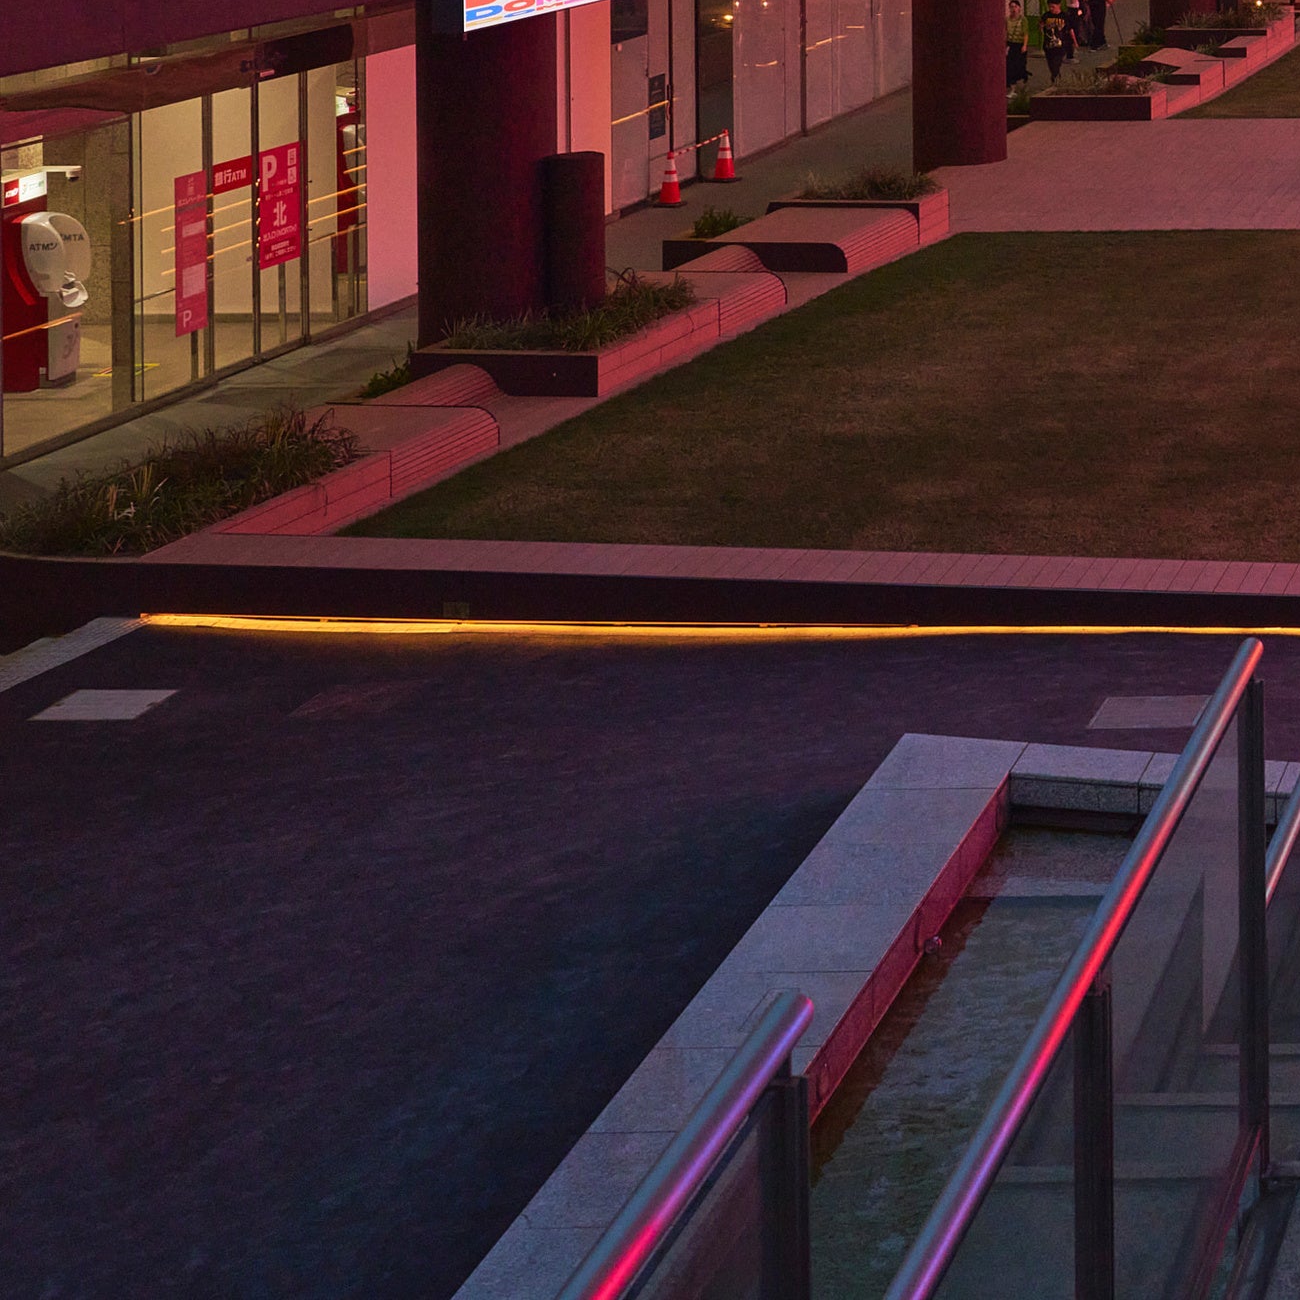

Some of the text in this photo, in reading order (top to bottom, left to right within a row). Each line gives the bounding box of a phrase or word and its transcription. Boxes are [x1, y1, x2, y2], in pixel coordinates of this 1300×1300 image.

[262, 154, 277, 192] P
[273, 201, 287, 227] 北
[183, 310, 192, 328] P
